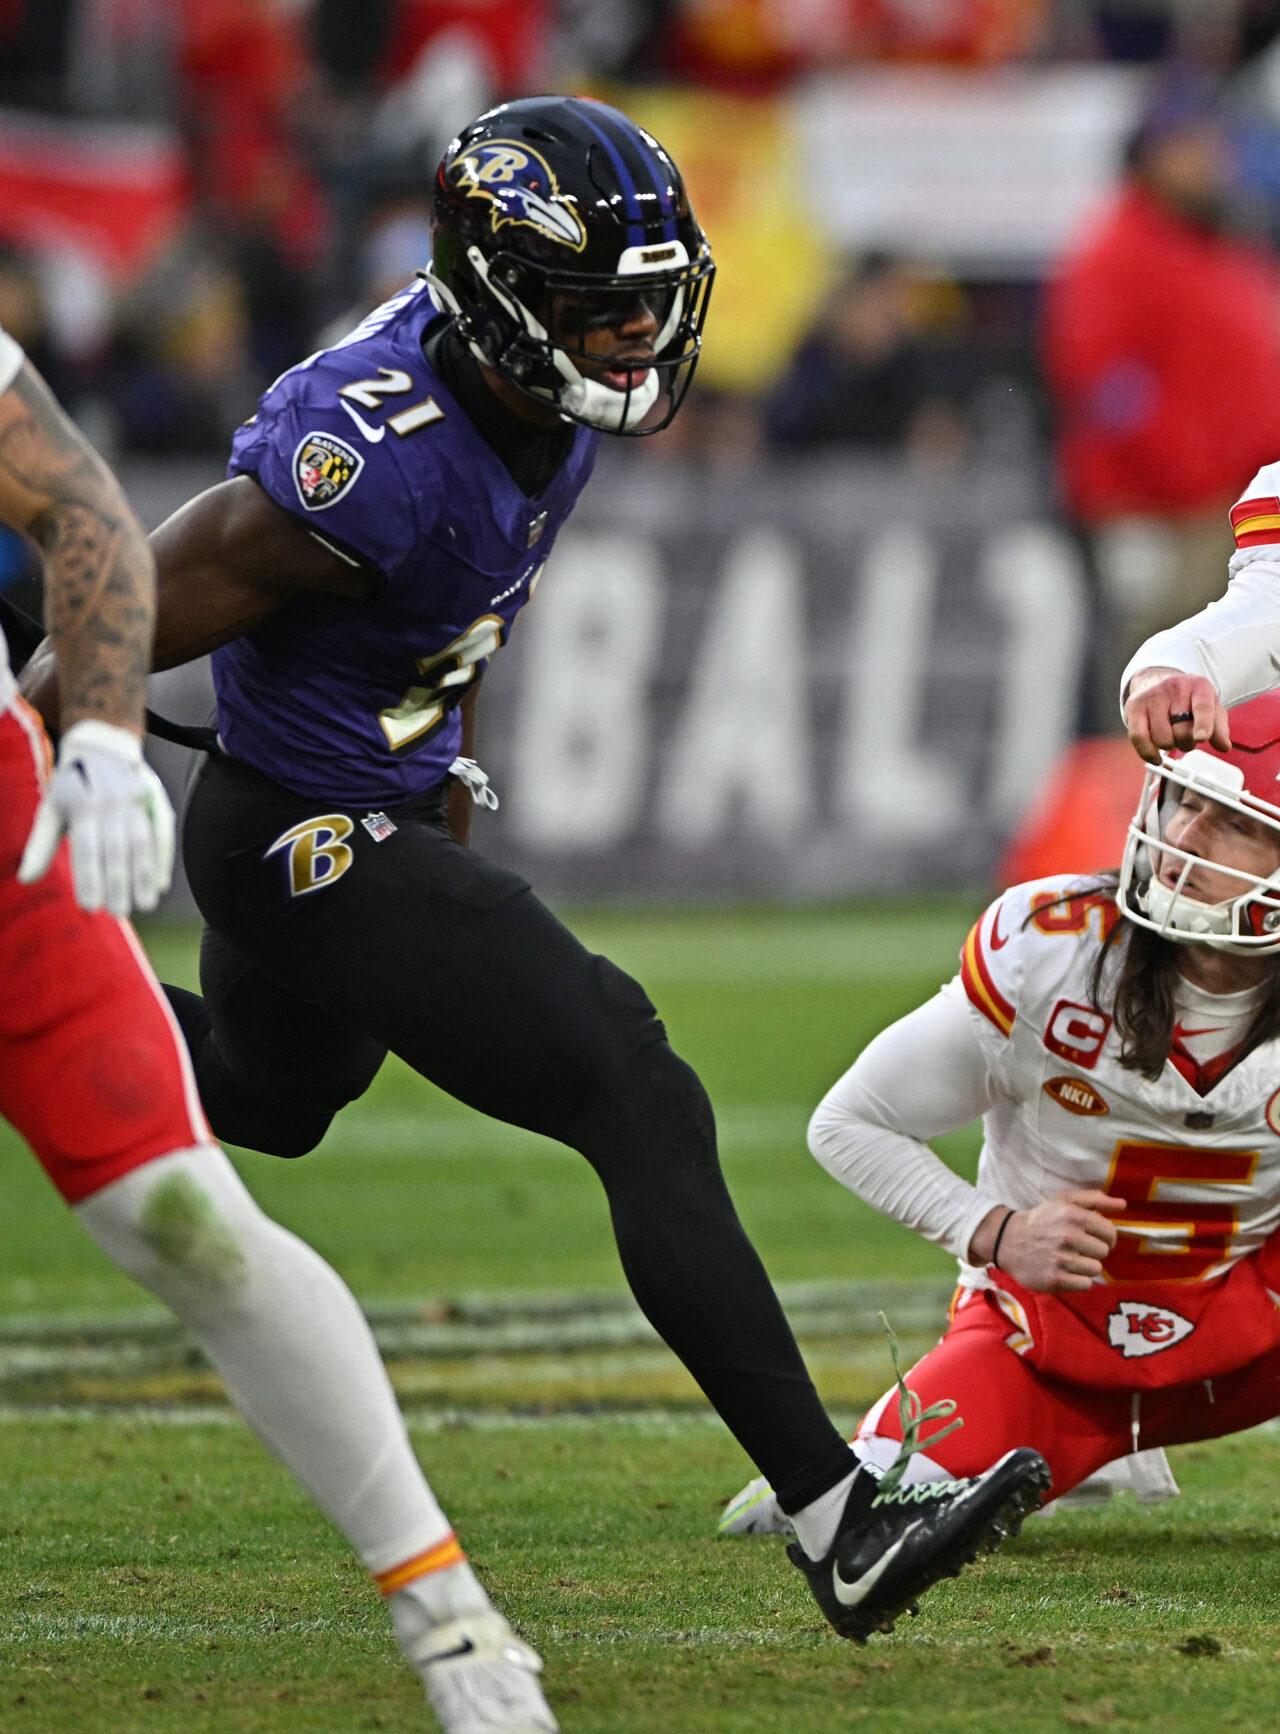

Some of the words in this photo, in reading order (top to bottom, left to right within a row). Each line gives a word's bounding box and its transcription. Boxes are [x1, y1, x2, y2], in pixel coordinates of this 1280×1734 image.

[337, 367, 446, 437] 21
[263, 814, 354, 897] B
[1030, 890, 1122, 944] 5
[1052, 1006, 1106, 1053] C
[1059, 1082, 1095, 1110] NKH
[1100, 1138, 1262, 1285] 5
[1126, 1312, 1176, 1343] KC
